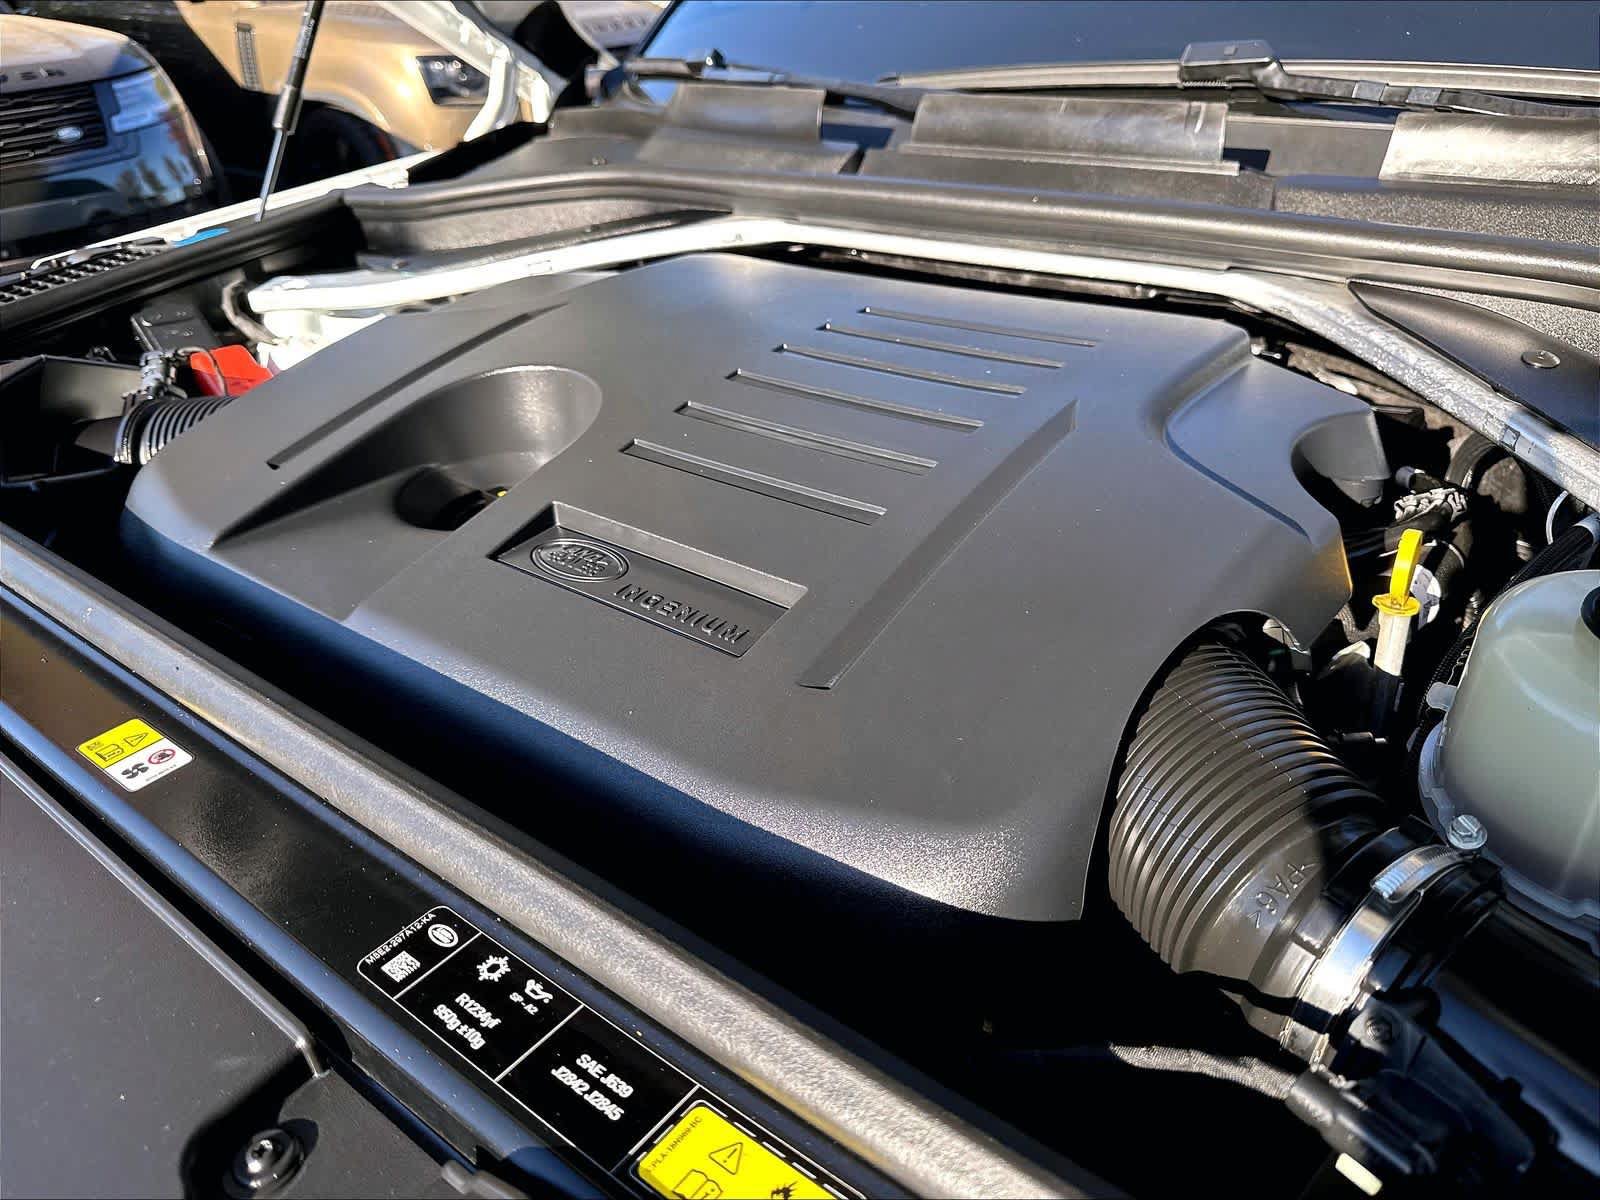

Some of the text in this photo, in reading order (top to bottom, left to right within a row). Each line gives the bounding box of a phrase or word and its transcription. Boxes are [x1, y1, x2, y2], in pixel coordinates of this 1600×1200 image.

[613, 583, 749, 643] INGENIUM
[433, 1004, 486, 1050] 950g ±10g
[455, 993, 501, 1029] R1234yf
[551, 1066, 625, 1121] J2842 J2845
[576, 1054, 634, 1099] SAE J639
